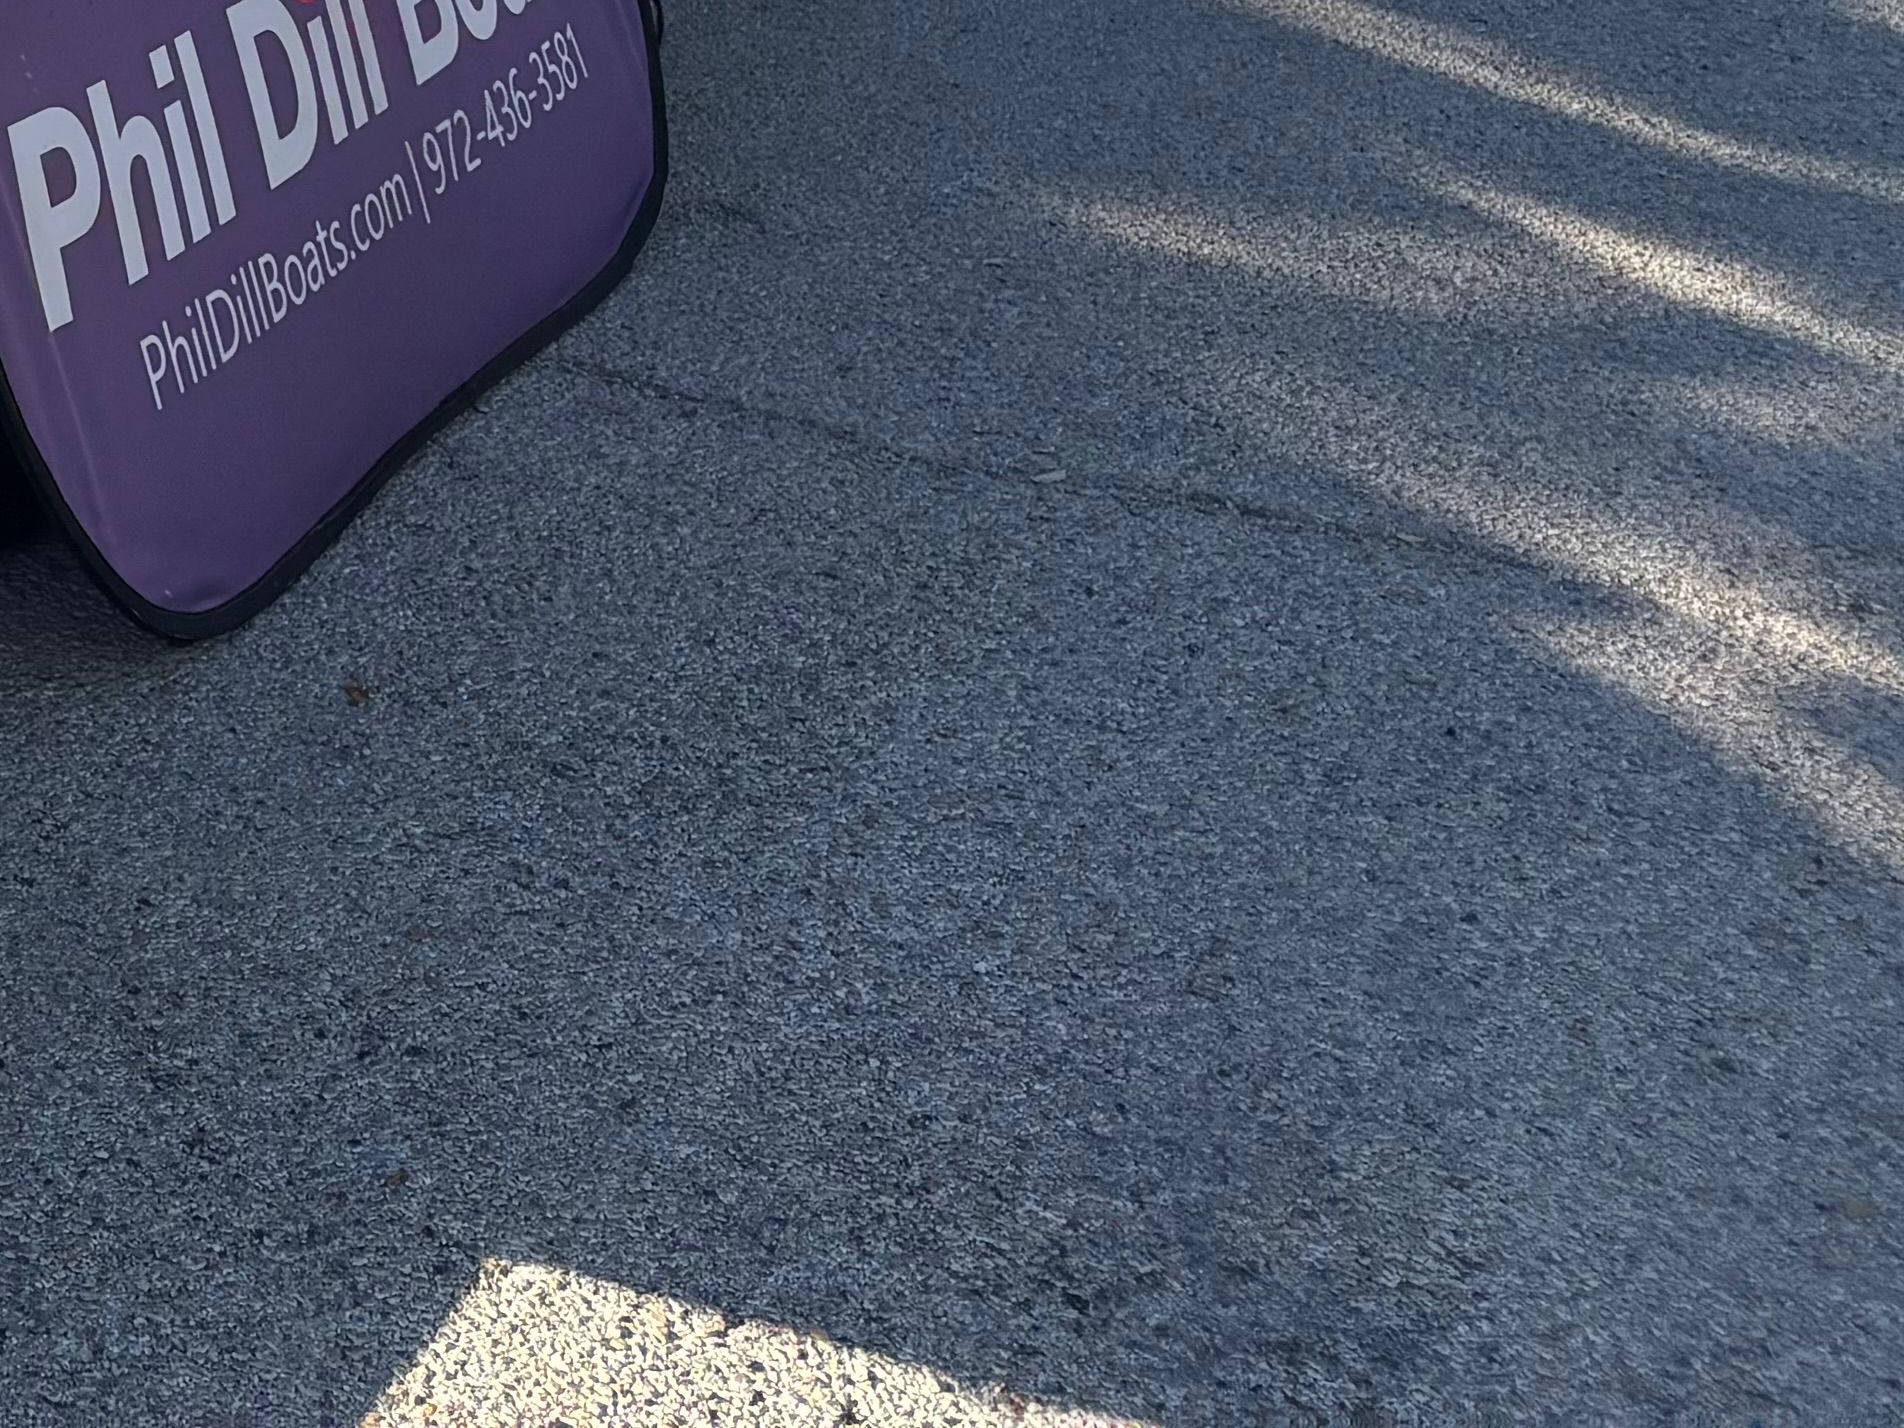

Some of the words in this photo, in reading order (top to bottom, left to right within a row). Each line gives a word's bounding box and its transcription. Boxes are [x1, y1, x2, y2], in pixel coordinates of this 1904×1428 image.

[6, 29, 237, 333] Phil
[139, 167, 413, 411] PhilDillBoats.com
[421, 22, 588, 197] 972-436-3581
